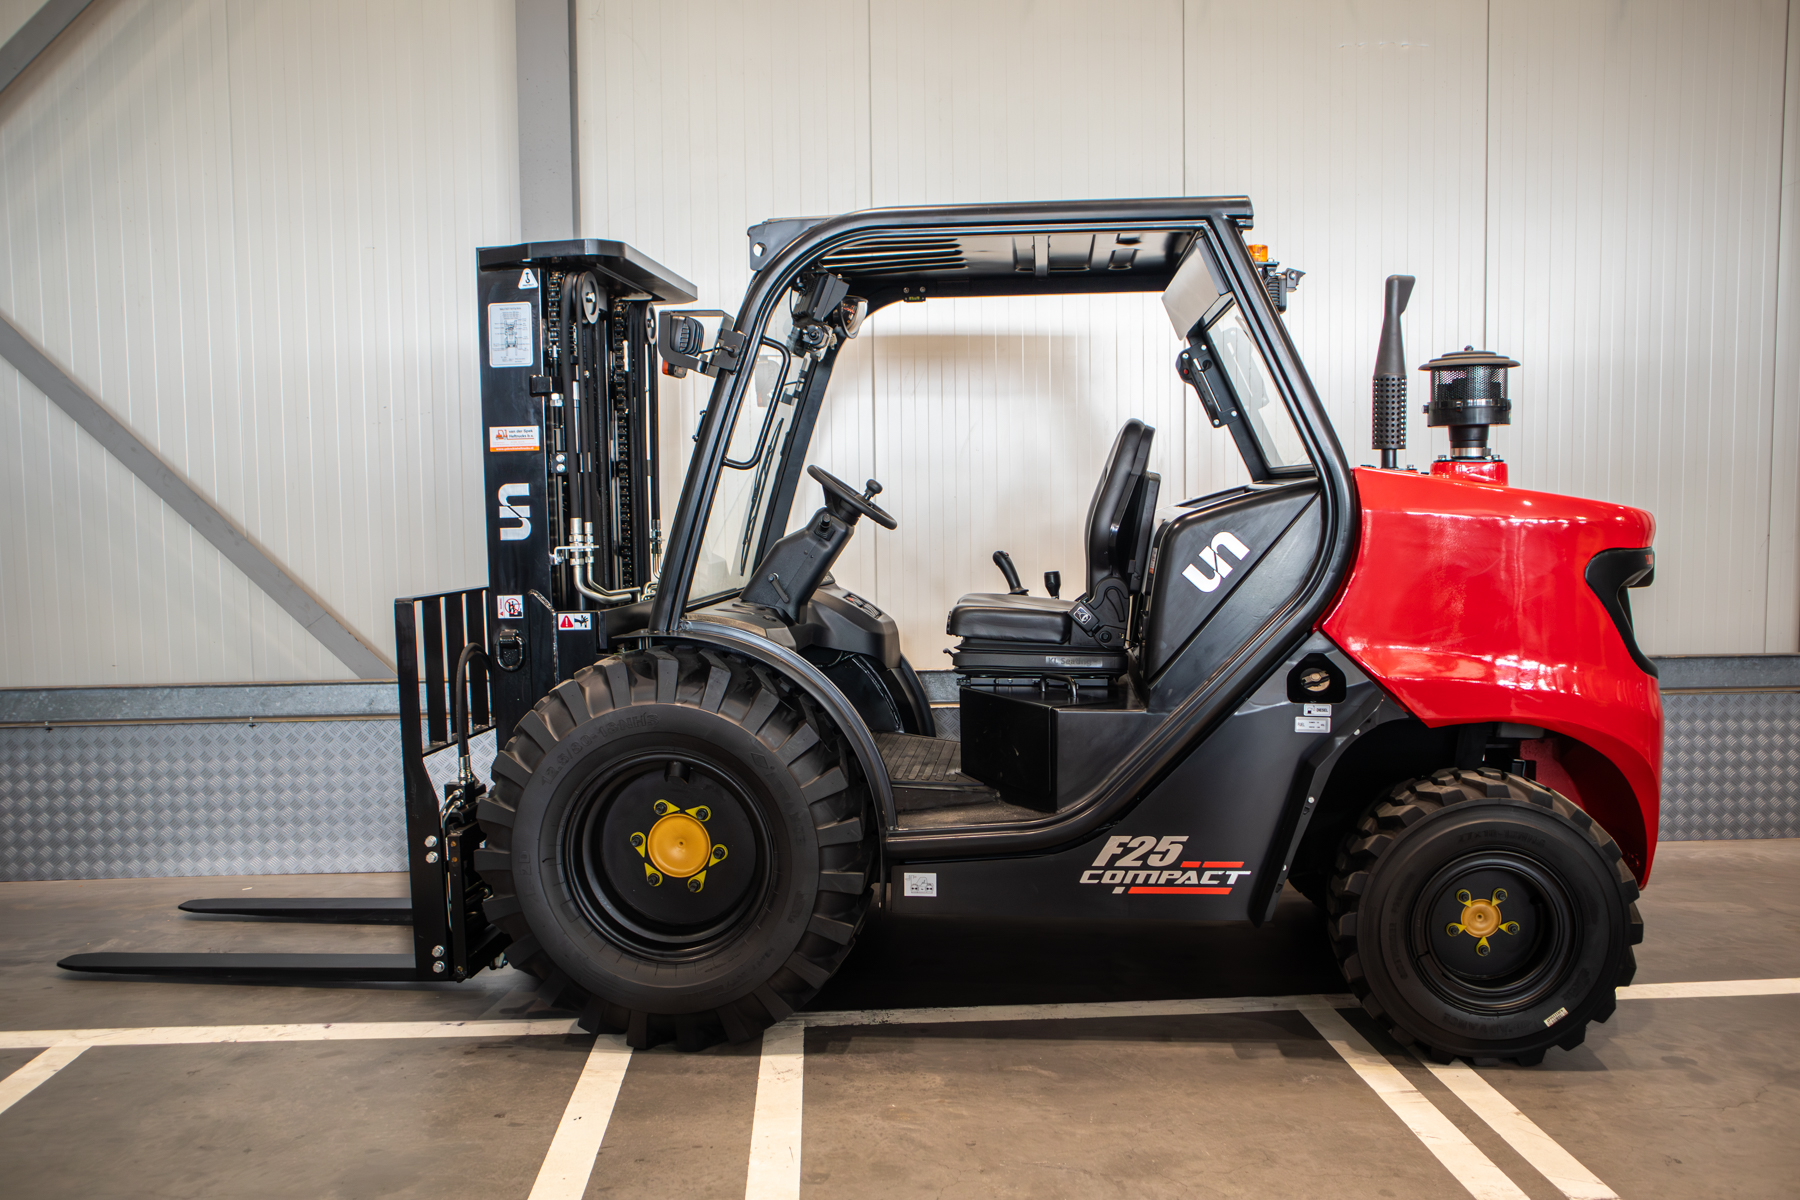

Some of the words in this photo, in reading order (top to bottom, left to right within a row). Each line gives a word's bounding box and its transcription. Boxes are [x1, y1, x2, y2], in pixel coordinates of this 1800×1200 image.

[1060, 657, 1092, 667] Seating
[1091, 835, 1190, 867] F25
[1079, 870, 1252, 885] COMPACT
